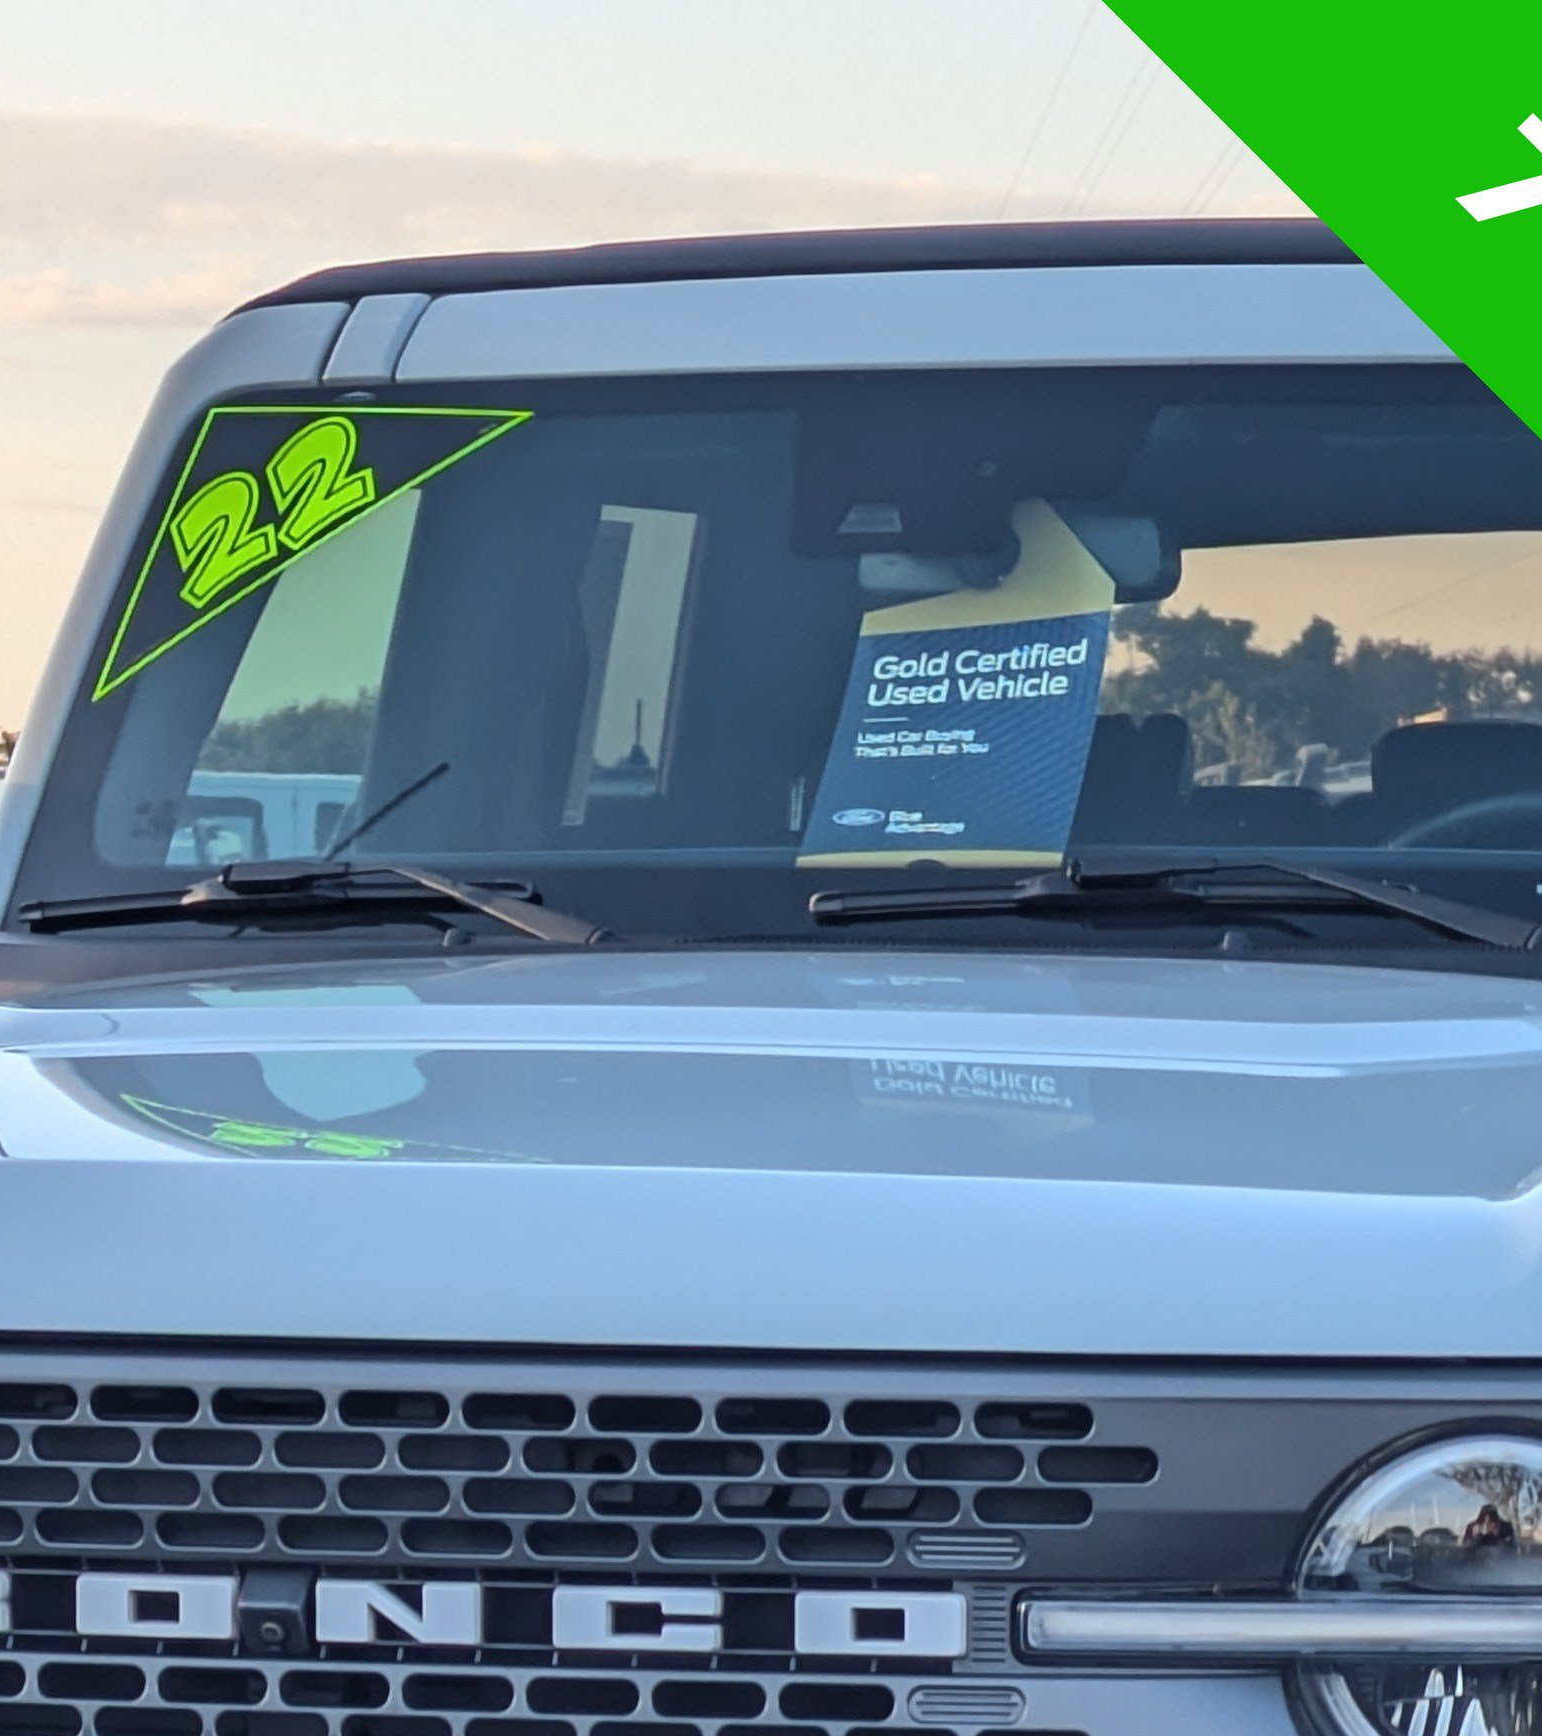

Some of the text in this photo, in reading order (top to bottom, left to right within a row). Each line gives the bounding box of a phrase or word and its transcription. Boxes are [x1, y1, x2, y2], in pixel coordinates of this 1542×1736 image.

[169, 416, 375, 610] 22
[872, 638, 1088, 680] Gold Certified
[867, 671, 1069, 707] Used Vehicle
